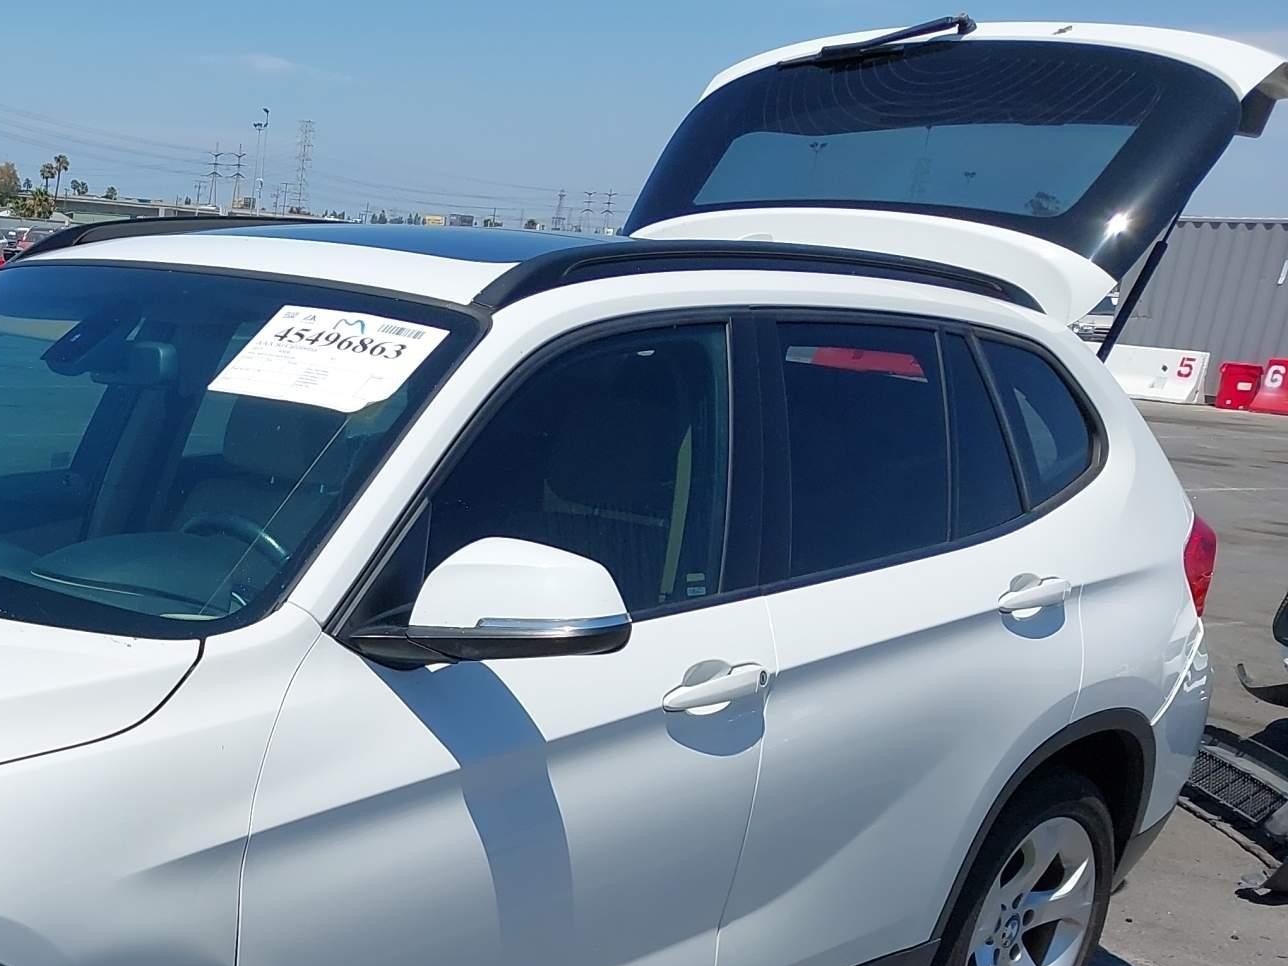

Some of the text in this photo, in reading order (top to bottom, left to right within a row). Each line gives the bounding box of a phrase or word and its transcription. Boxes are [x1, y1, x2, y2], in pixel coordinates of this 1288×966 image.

[274, 326, 407, 359] 45496863
[1176, 356, 1196, 378] 5
[1264, 364, 1287, 389] 6
